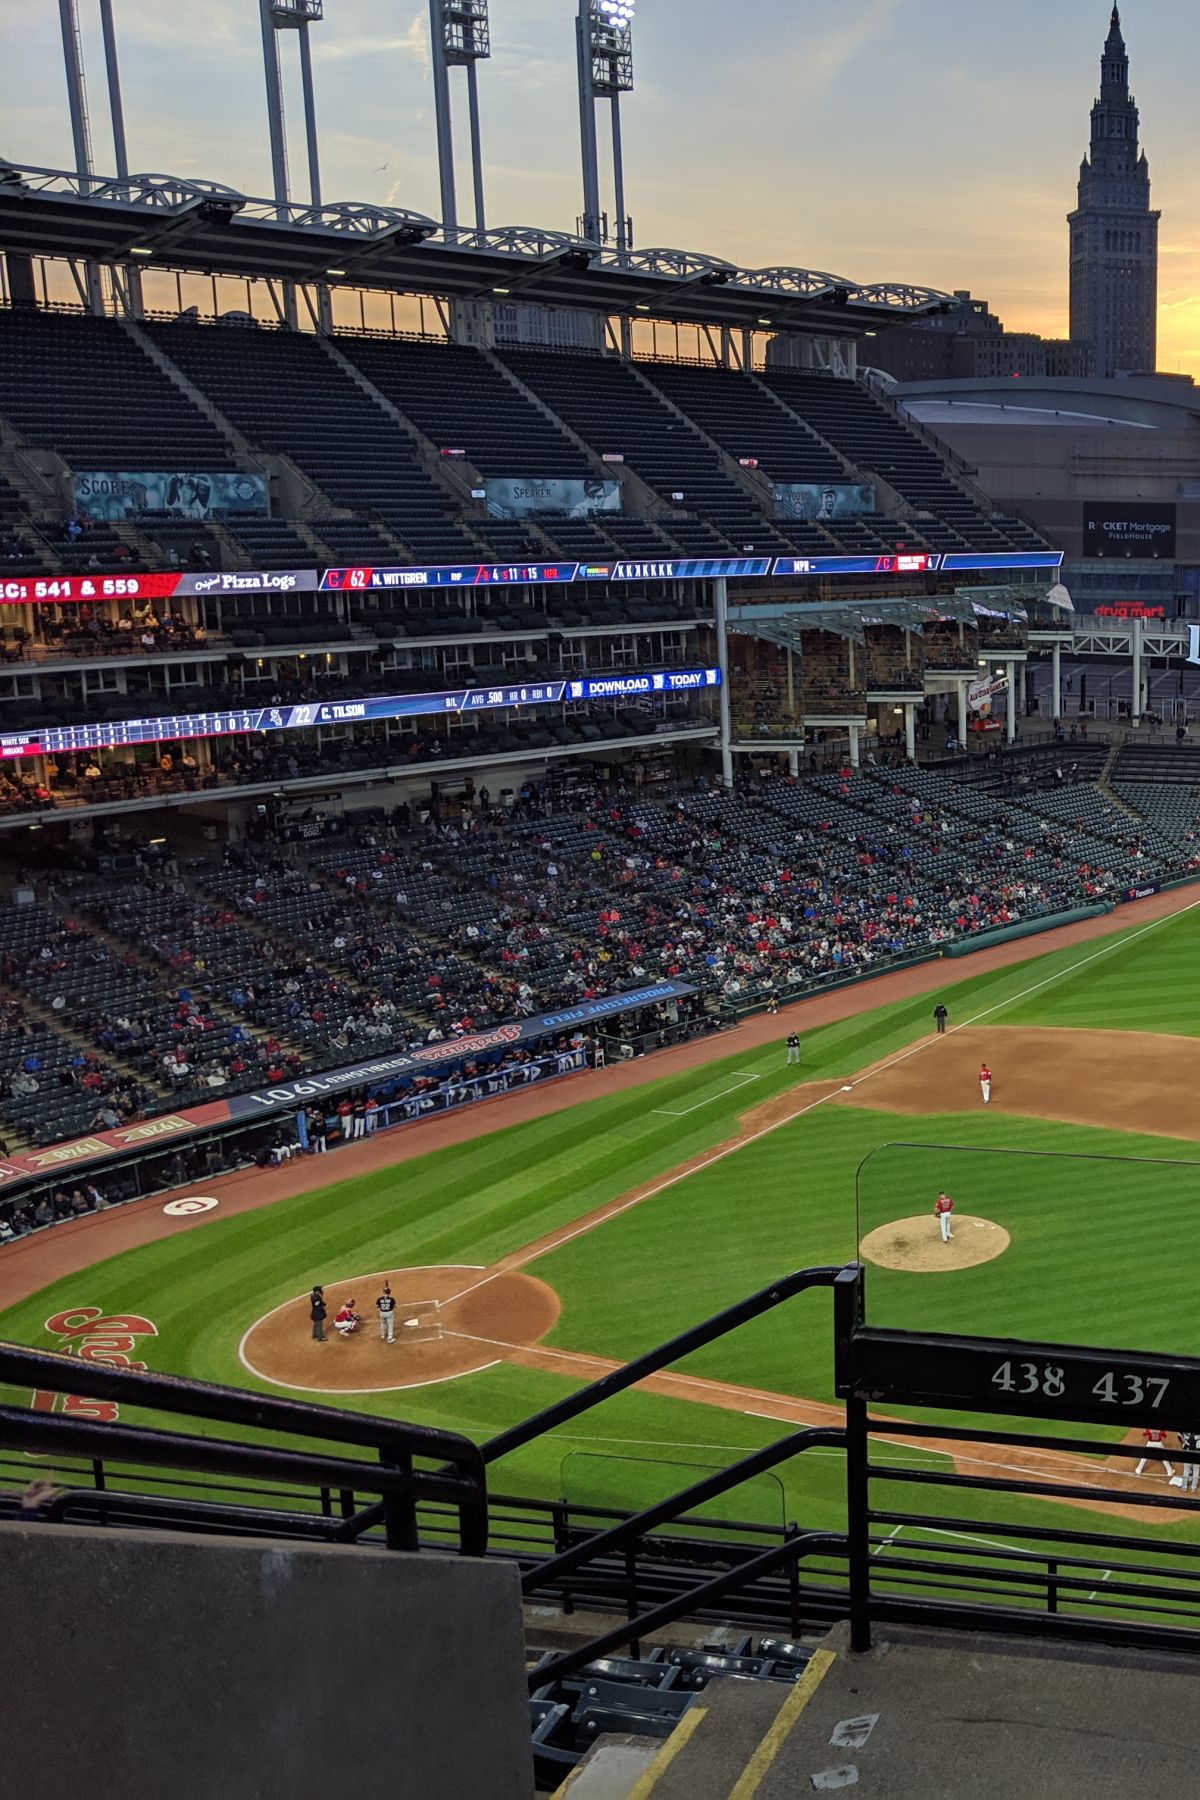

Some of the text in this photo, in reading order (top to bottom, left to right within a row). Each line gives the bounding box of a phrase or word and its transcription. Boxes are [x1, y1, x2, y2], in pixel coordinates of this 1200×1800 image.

[81, 478, 130, 496] SCORE
[1088, 522, 1171, 532] RCKET Mortgage
[508, 568, 518, 580] 11
[528, 567, 538, 580] 15
[794, 560, 810, 572] MPH
[222, 574, 262, 588] Pizza
[262, 574, 297, 591] Logs
[350, 570, 462, 588] 62 N. WITTGREN RHP
[35, 580, 71, 598] 541
[80, 580, 97, 596] &
[103, 579, 140, 595] 559
[1094, 604, 1128, 620] drug
[1130, 605, 1164, 617] mart
[590, 678, 649, 694] DOWNLOAD
[668, 673, 702, 686] TODAY
[471, 692, 503, 705] AVG .500
[510, 692, 518, 702] HR
[532, 690, 542, 700] RBI
[296, 704, 365, 724] 22 C. TILSON
[1136, 886, 1154, 898] Fanatics
[543, 985, 676, 1026] PROGRESSIVE FIELD
[411, 1024, 522, 1061] Indians
[250, 1056, 412, 1107] ESTABLISHED 1901
[138, 1120, 184, 1136] 1920
[52, 1142, 100, 1160] 1948
[992, 1361, 1172, 1409] 438 437
